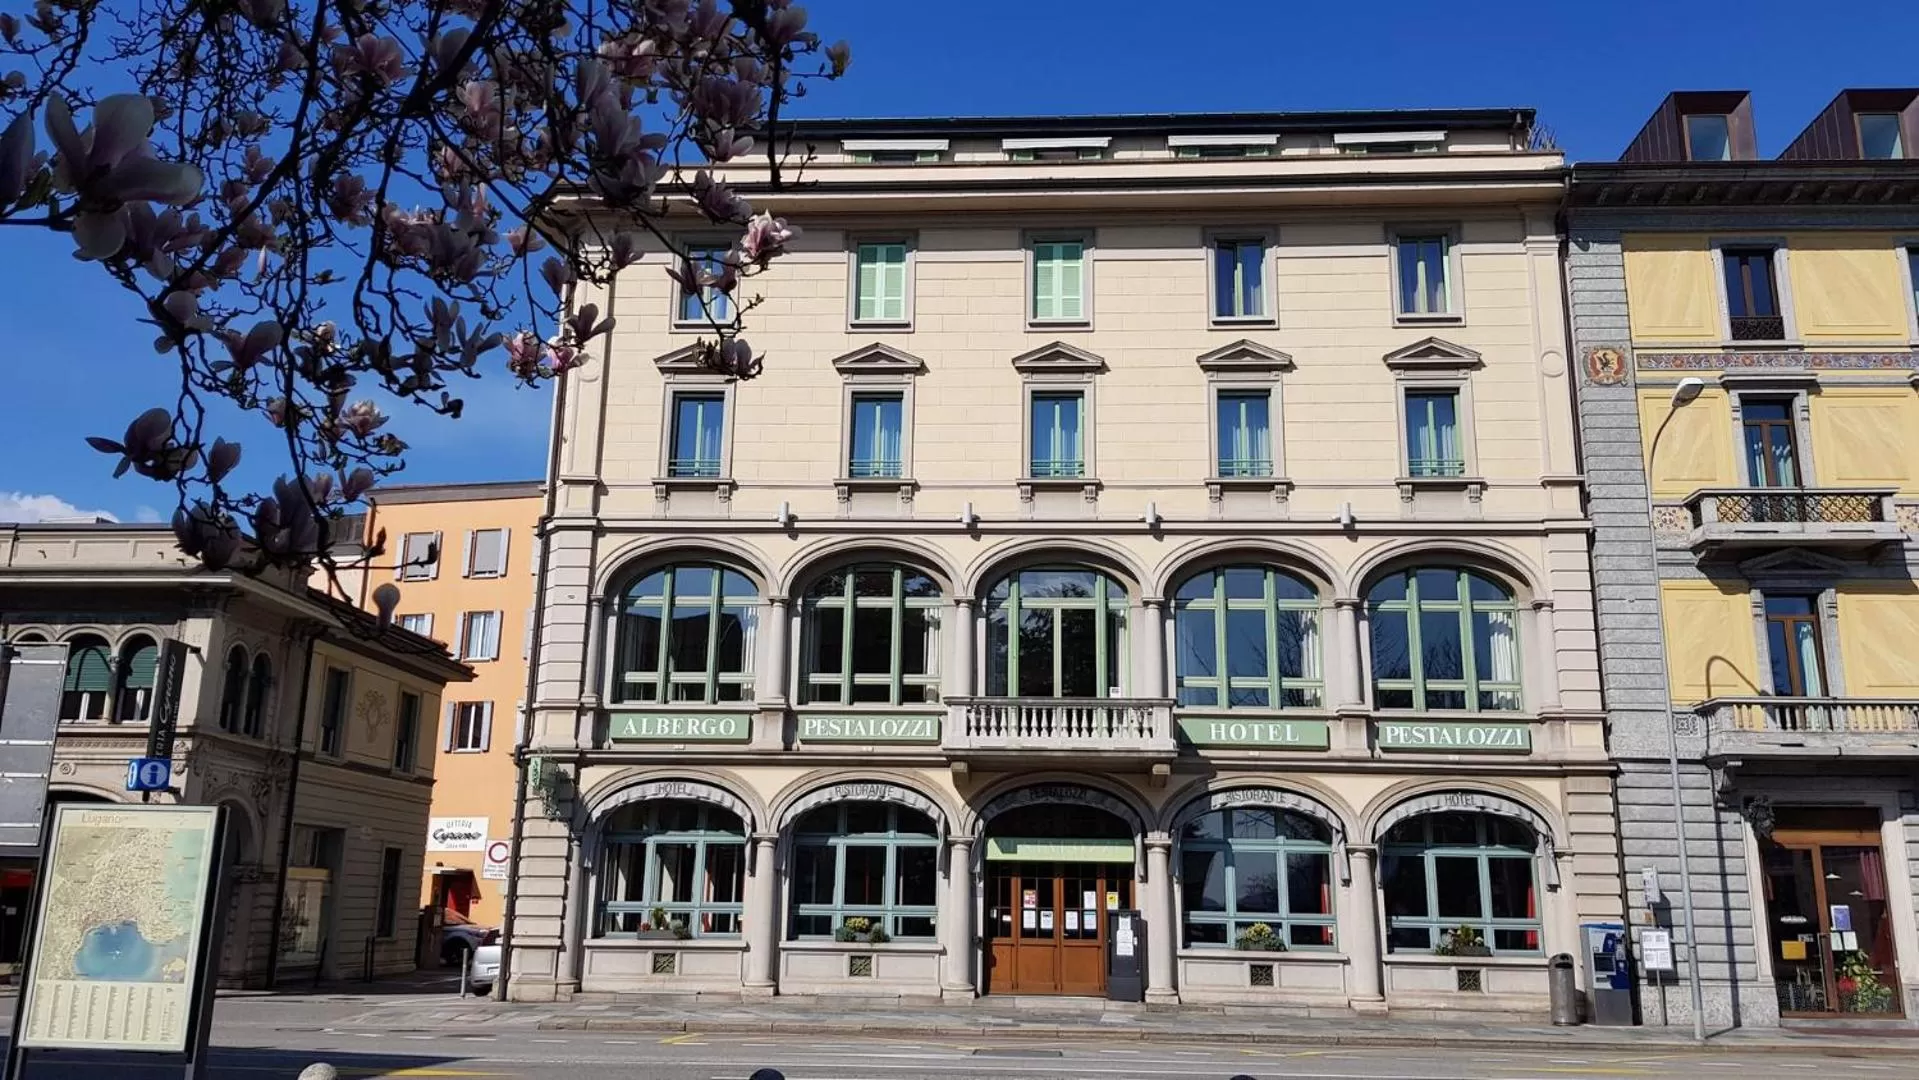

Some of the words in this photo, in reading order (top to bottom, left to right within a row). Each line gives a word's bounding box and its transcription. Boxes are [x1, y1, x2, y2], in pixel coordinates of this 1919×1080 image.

[623, 716, 736, 737] ALBERGO
[804, 717, 933, 738] PESTALOZZI
[1209, 722, 1300, 742] HOTEL
[1385, 726, 1523, 747] PESTALOZZI
[657, 783, 688, 795] HOTEL
[834, 785, 895, 797] RISTORANTE
[1225, 788, 1287, 802] RISTORANTE
[1444, 794, 1476, 806] HOTEL
